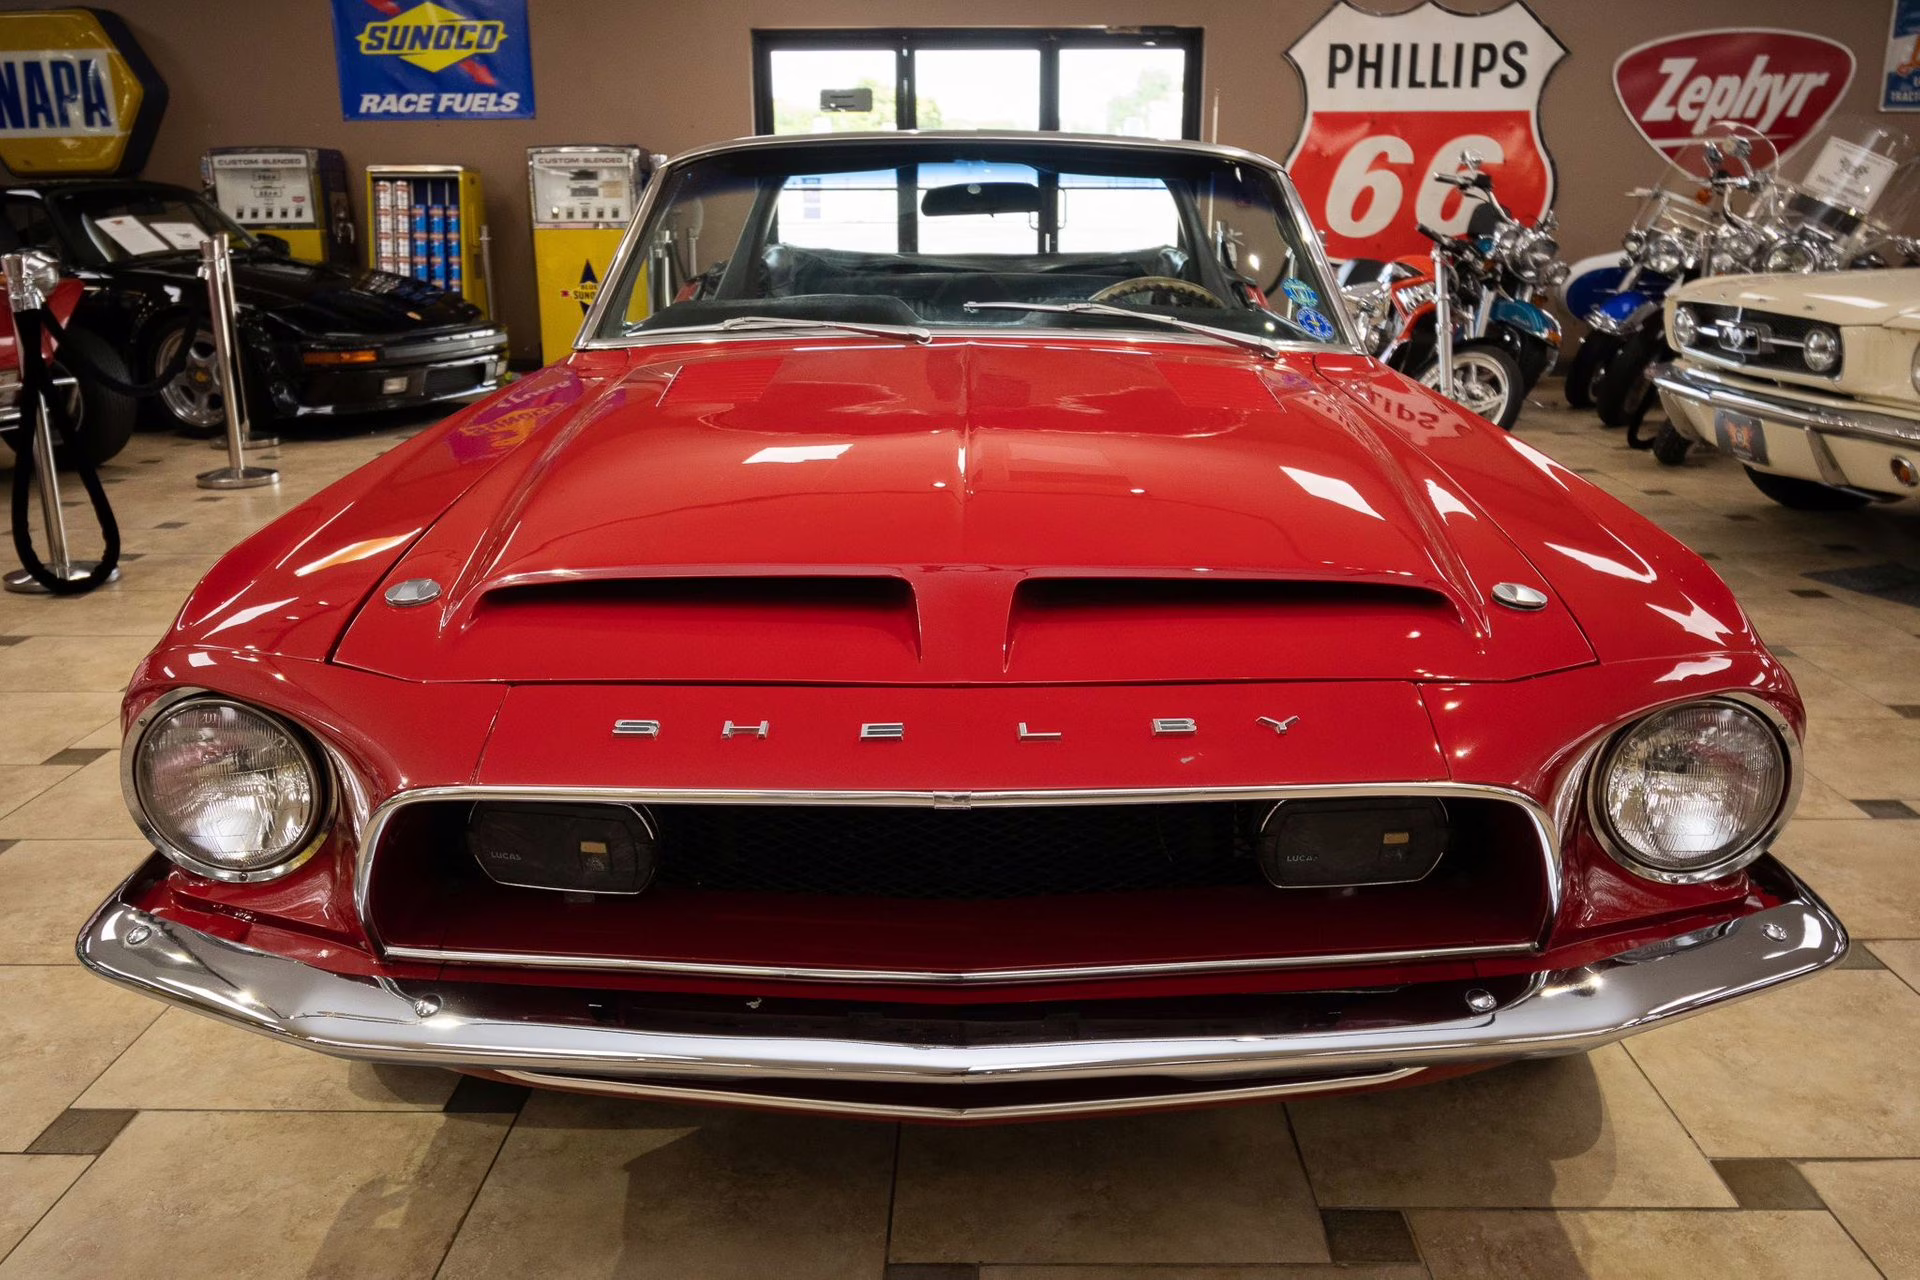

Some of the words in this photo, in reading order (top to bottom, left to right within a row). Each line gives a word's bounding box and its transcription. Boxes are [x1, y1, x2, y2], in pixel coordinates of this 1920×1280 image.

[365, 24, 499, 51] SUNOCO
[1327, 40, 1529, 89] PHILLIPS
[0, 60, 112, 129] NAPA
[359, 93, 435, 113] RACE
[437, 92, 520, 113] FUELS
[1641, 54, 1831, 135] Zephyr
[1325, 134, 1505, 239] 66
[612, 715, 1300, 741] SHELBY
[490, 851, 522, 861] LUCAS
